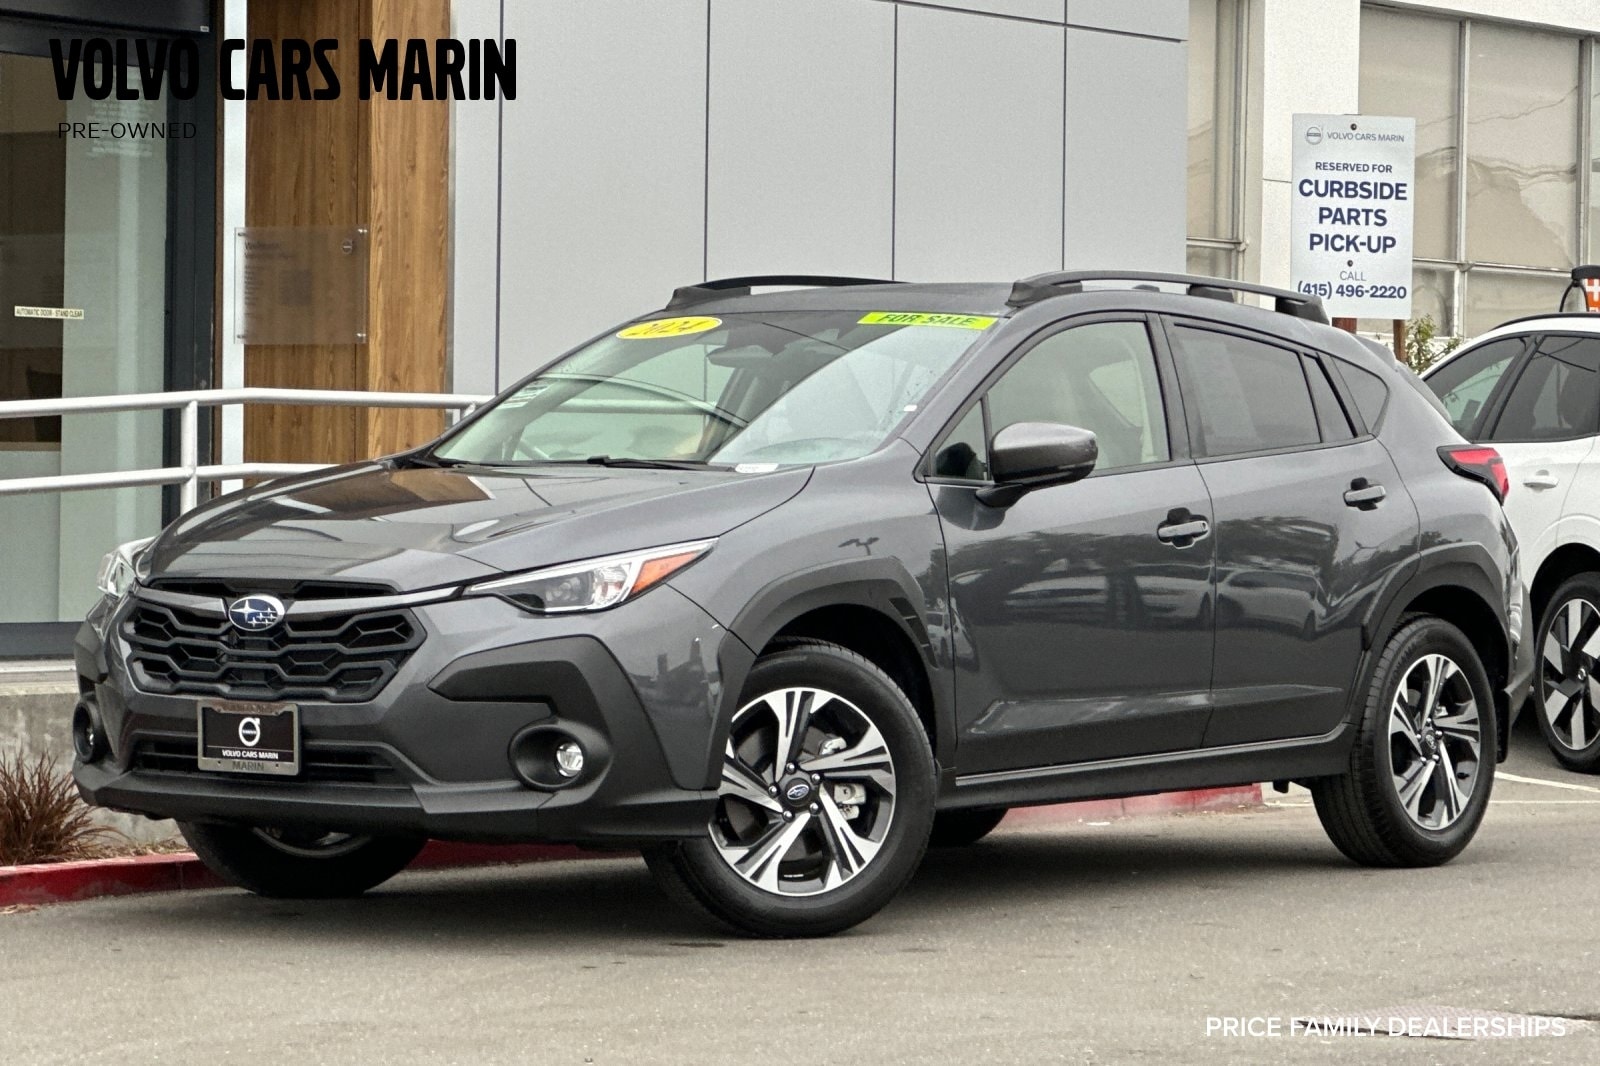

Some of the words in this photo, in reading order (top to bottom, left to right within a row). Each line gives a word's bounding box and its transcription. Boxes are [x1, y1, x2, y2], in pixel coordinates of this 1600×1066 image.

[1326, 131, 1354, 141] VOLVO
[1355, 132, 1377, 142] CARS
[1378, 133, 1405, 143] MARIN
[1315, 161, 1370, 173] RESERVED
[1371, 163, 1393, 174] FOR
[1299, 178, 1408, 200] CURBSIDE
[1318, 206, 1388, 227] PARTS
[1309, 233, 1396, 254] PICK-UP
[1339, 270, 1367, 282] CALL
[1297, 280, 1333, 300] (415)
[1335, 284, 1407, 300] 496-2220
[878, 314, 921, 324] FOR
[922, 315, 976, 326] SALE
[222, 749, 241, 758] VOLVO
[241, 750, 258, 759] CARS
[258, 751, 279, 760] MARIN
[232, 760, 265, 771] MARIN
